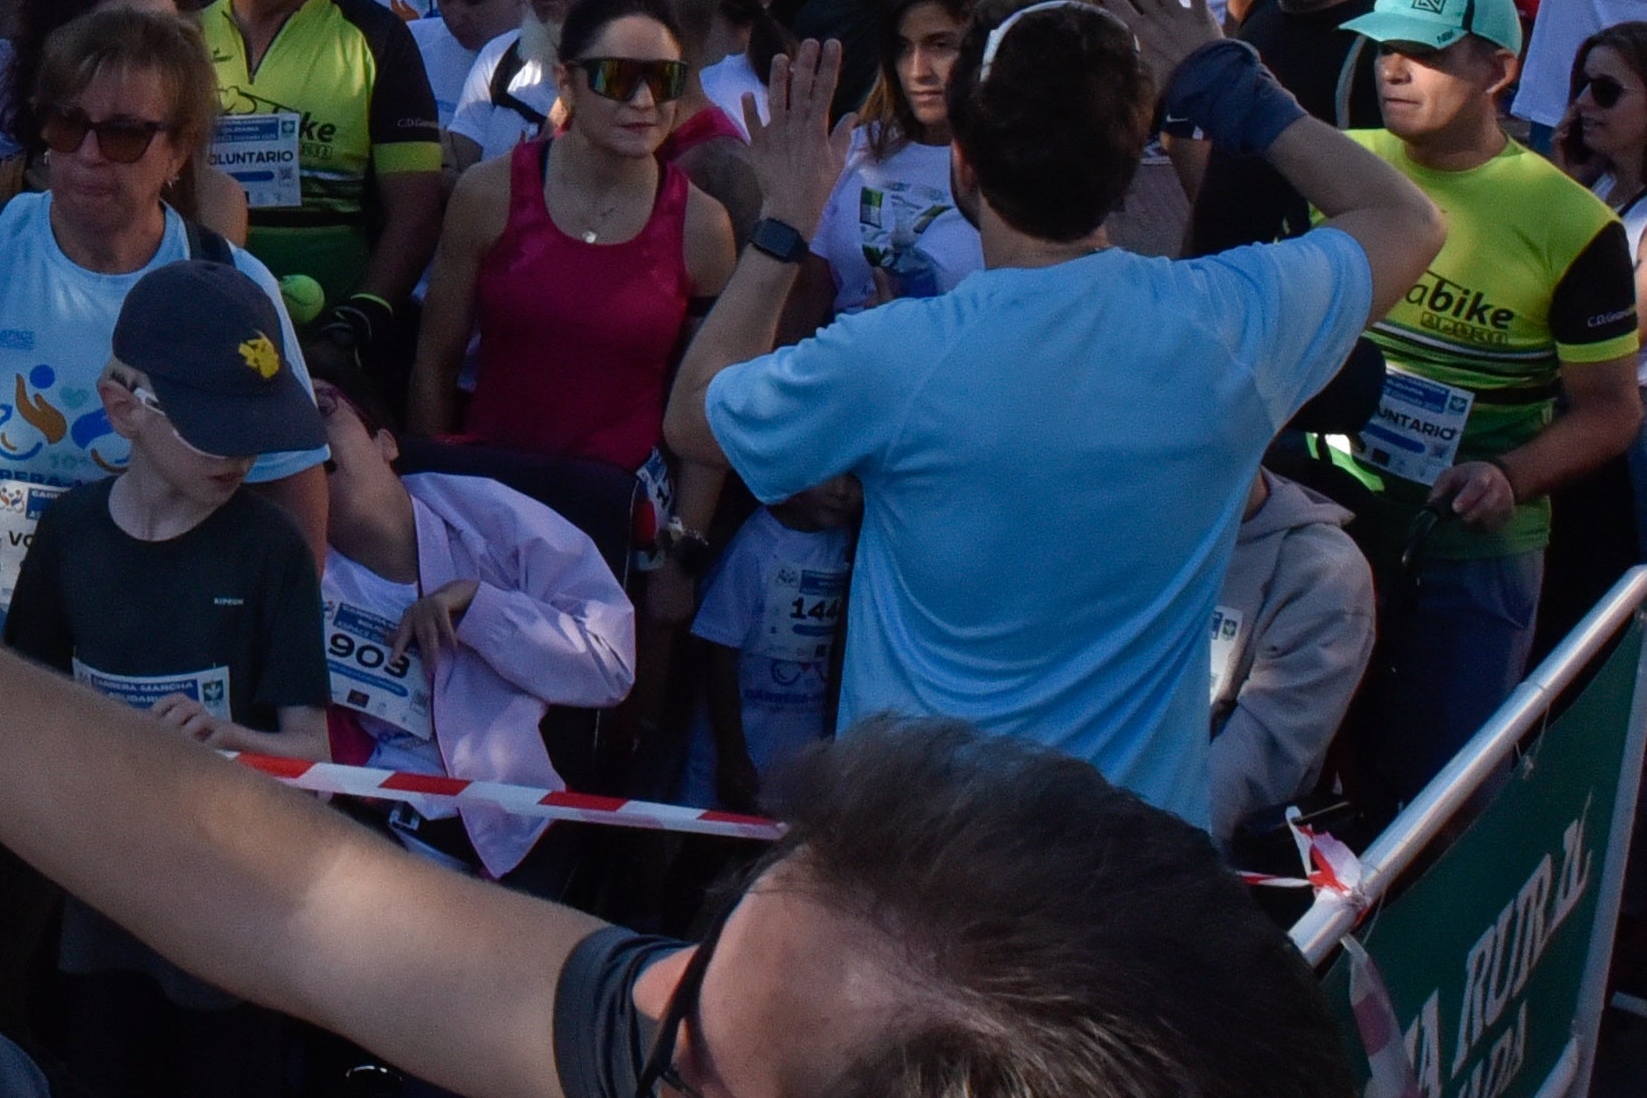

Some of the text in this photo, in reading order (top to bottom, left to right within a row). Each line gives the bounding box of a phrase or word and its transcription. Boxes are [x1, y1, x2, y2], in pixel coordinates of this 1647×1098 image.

[209, 150, 294, 166] OLUNTARIO
[1405, 279, 1515, 330] abike
[1376, 406, 1457, 442] UNTARIO
[790, 596, 841, 621] 144
